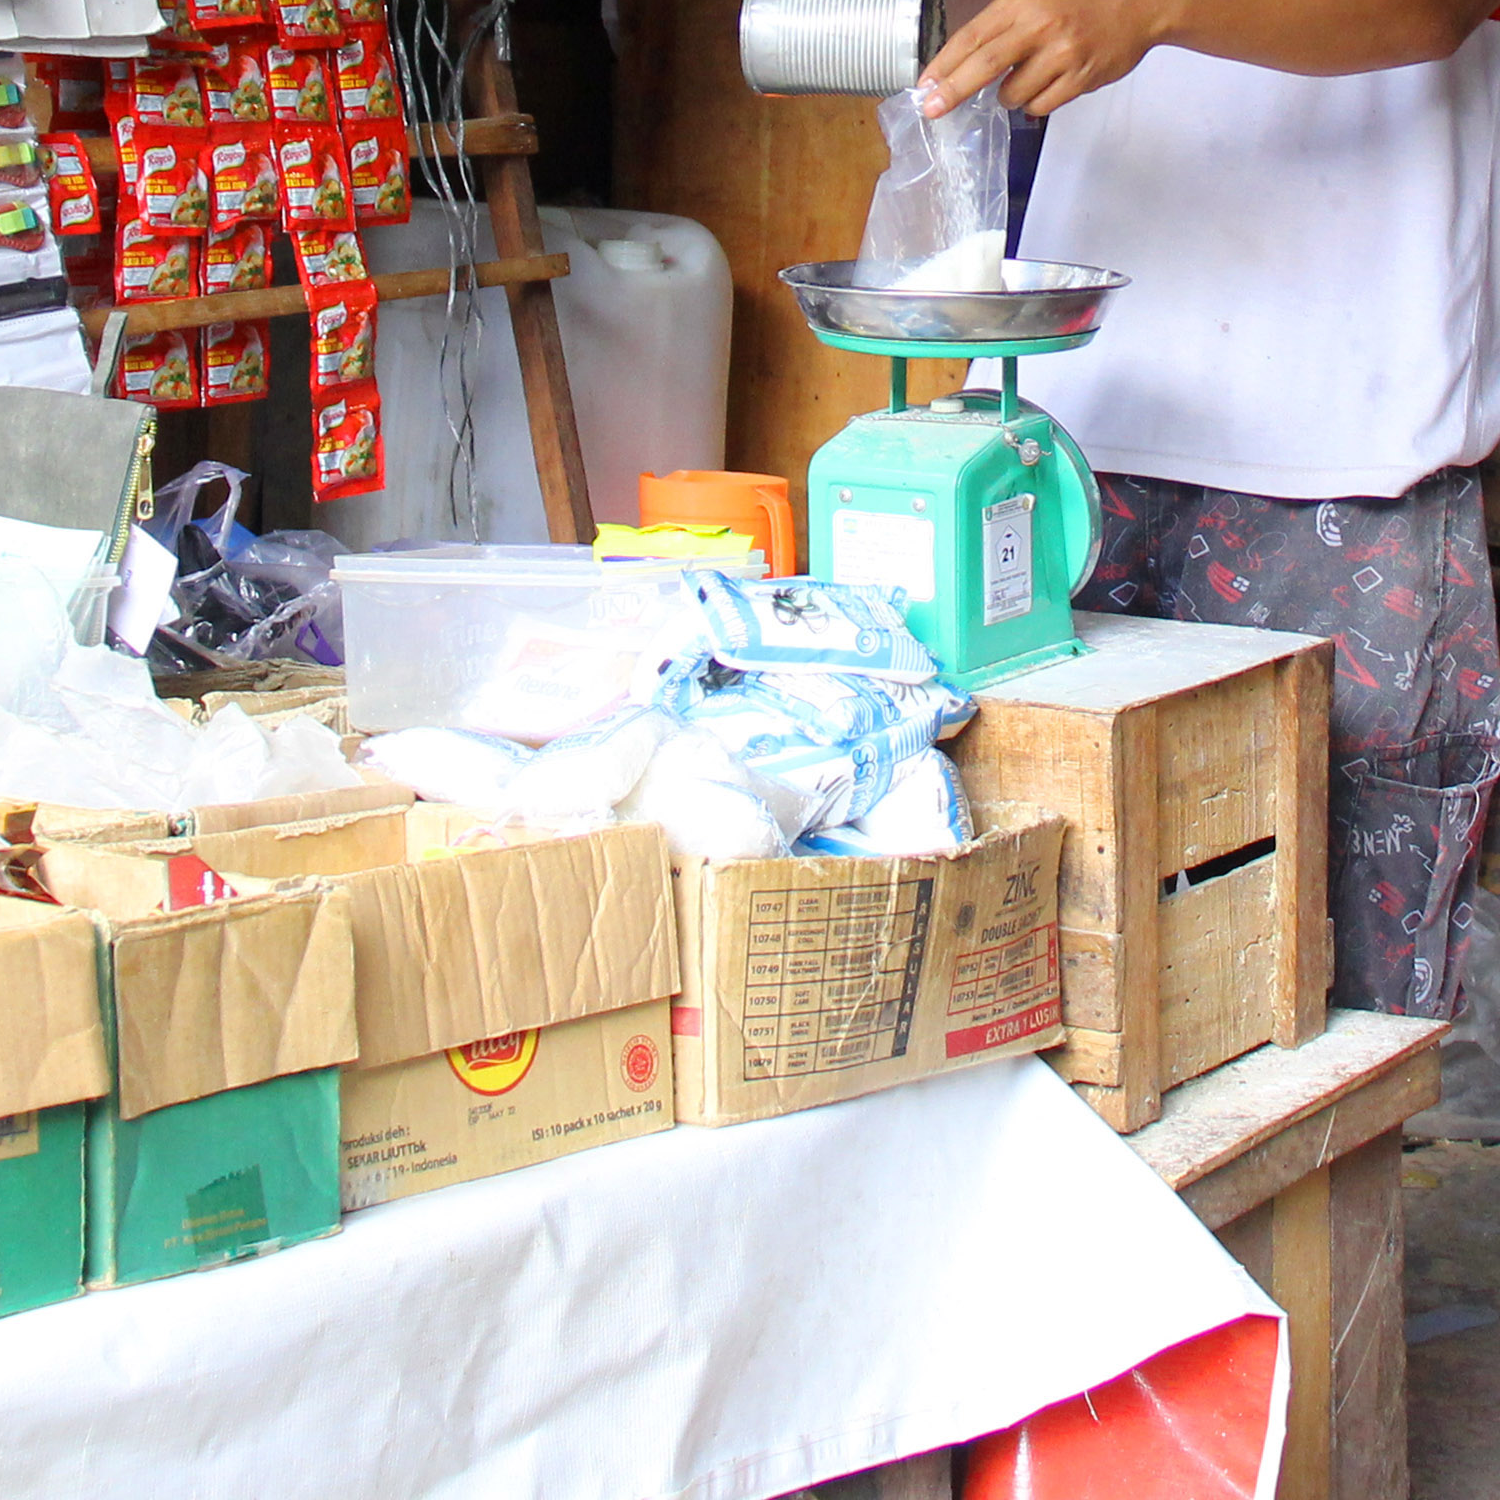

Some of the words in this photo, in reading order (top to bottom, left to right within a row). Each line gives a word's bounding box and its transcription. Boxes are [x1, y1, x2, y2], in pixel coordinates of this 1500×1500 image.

[1002, 546, 1014, 562] 21
[755, 902, 783, 915] 10747
[753, 932, 781, 944] 10748
[981, 922, 1017, 944] DOUBLE
[751, 963, 779, 976] 10749
[749, 995, 777, 1007] 10750
[748, 1025, 775, 1037] 10751
[985, 1020, 1021, 1045] EXTRA
[532, 1129, 544, 1141] ISI
[551, 1124, 562, 1136] 10
[564, 1119, 585, 1135] pack
[594, 1112, 605, 1124] 10
[607, 1107, 636, 1121] sachet
[643, 1101, 654, 1112] 20
